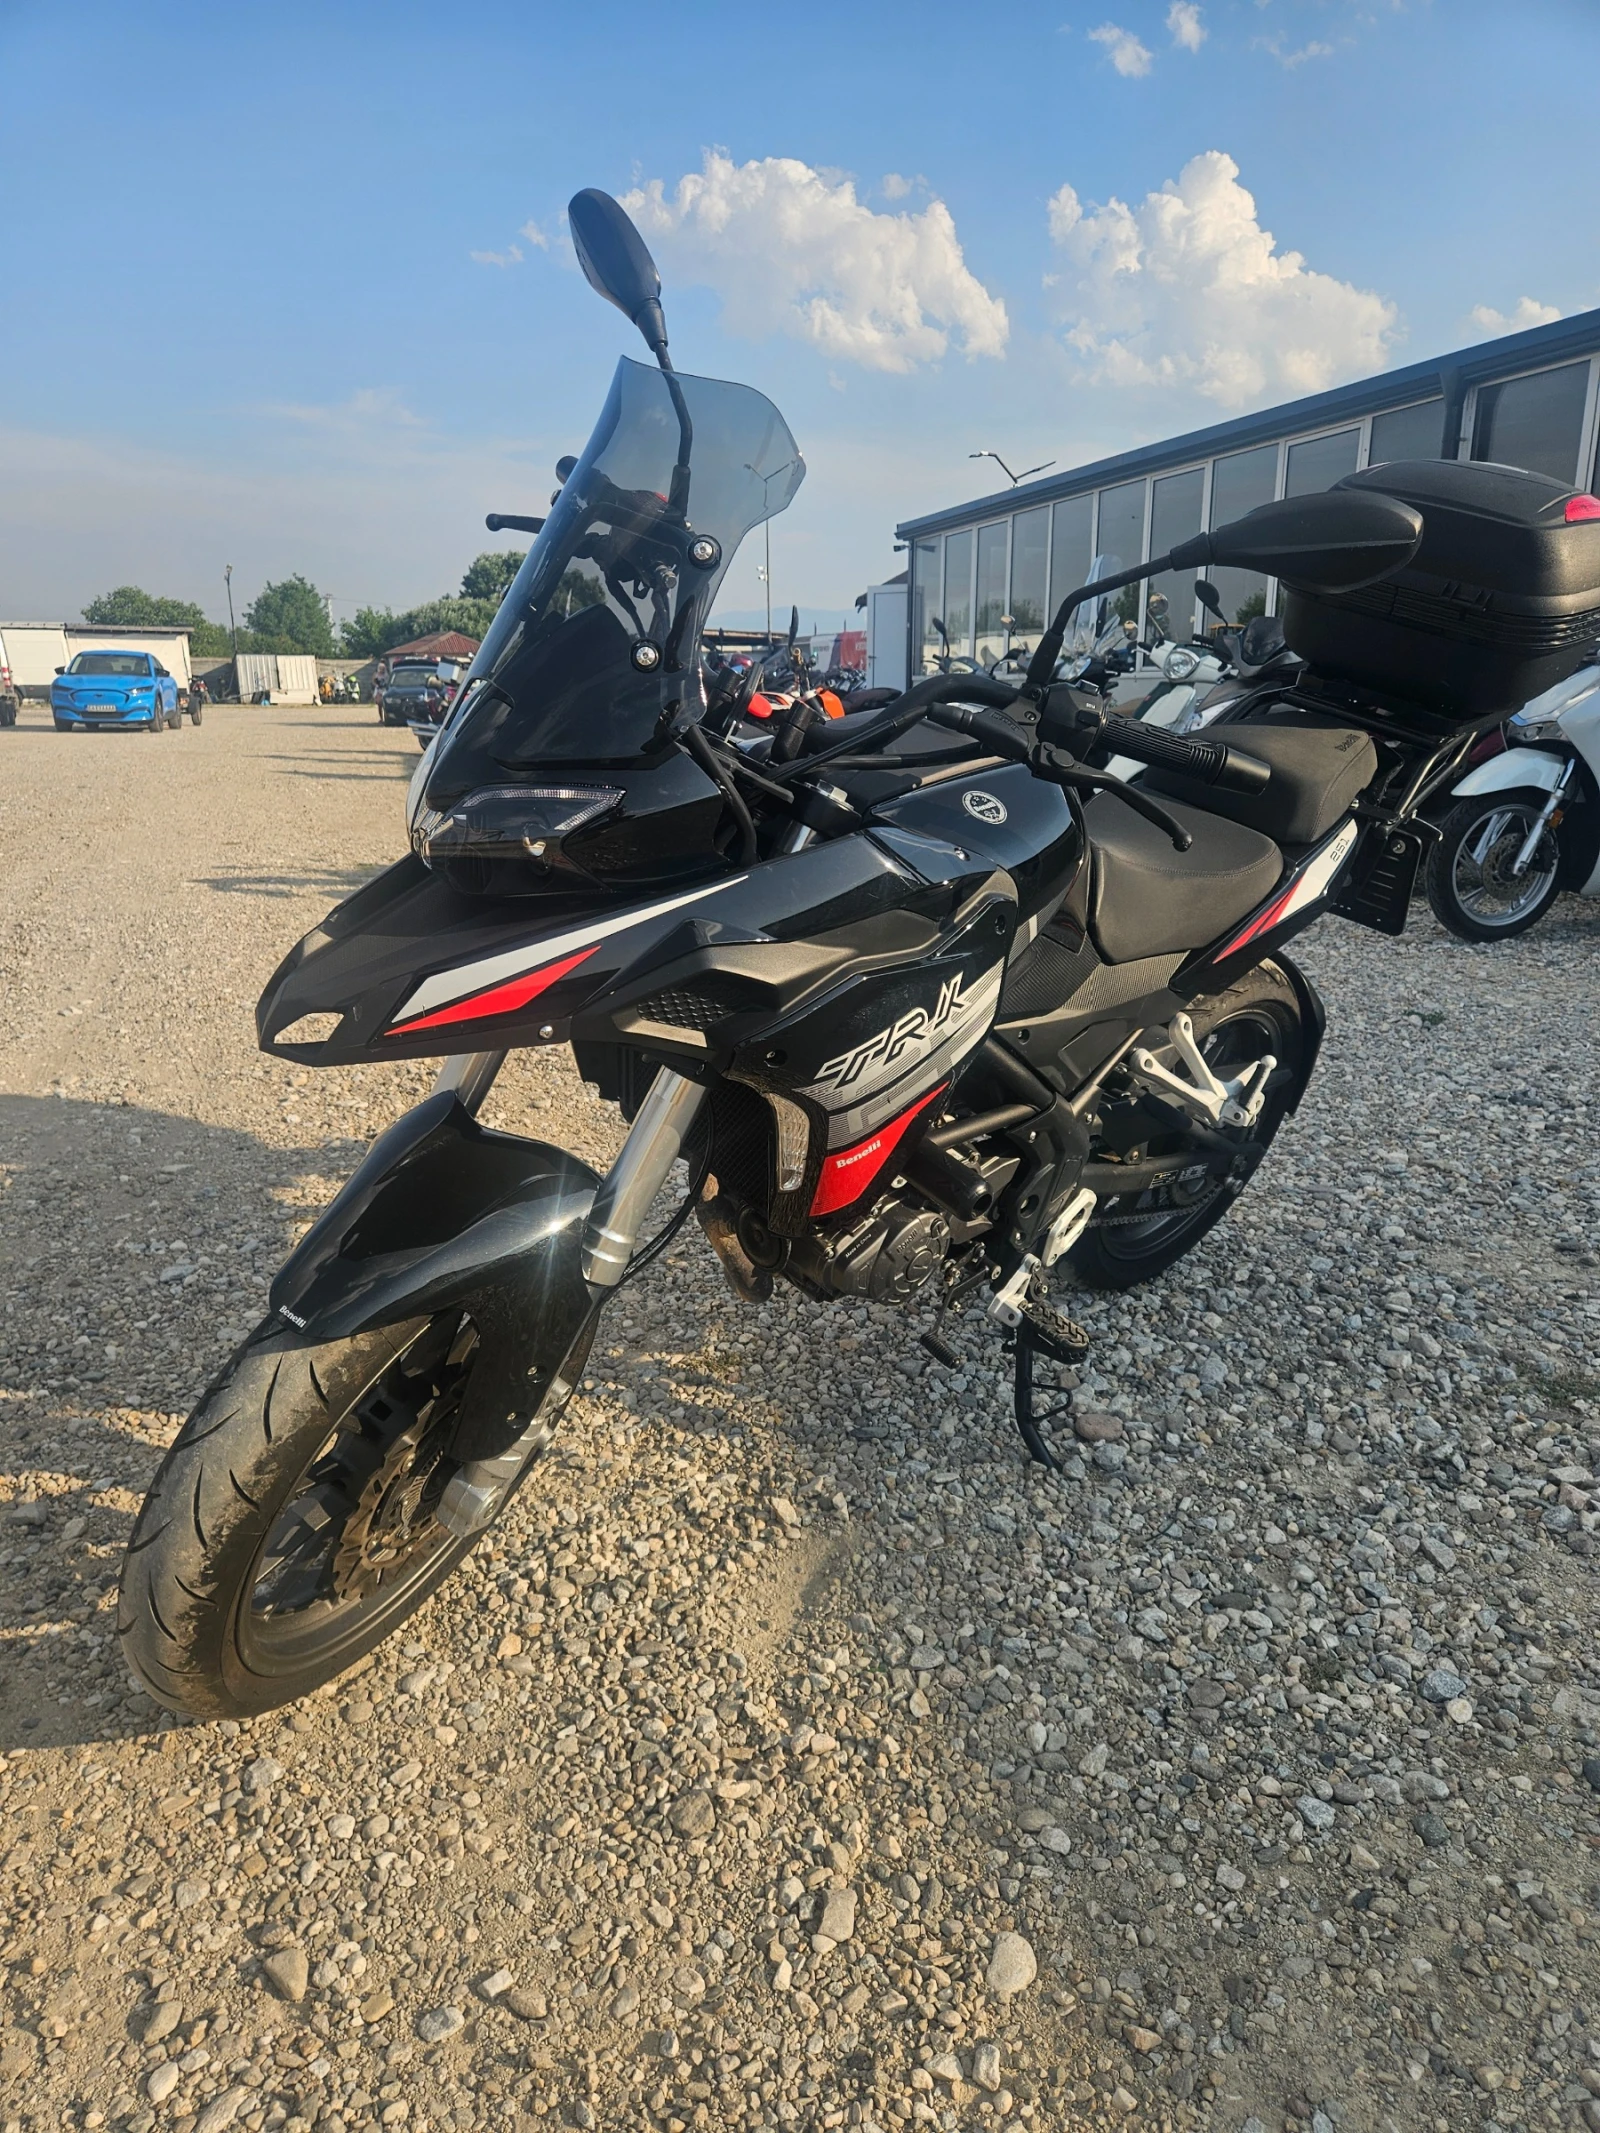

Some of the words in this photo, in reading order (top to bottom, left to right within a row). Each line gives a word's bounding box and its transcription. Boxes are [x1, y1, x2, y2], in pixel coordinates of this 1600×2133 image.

[1330, 838, 1350, 862] 251
[813, 971, 967, 1090] TRK
[836, 1139, 881, 1168] Benelli
[279, 1305, 307, 1328] Benelli
